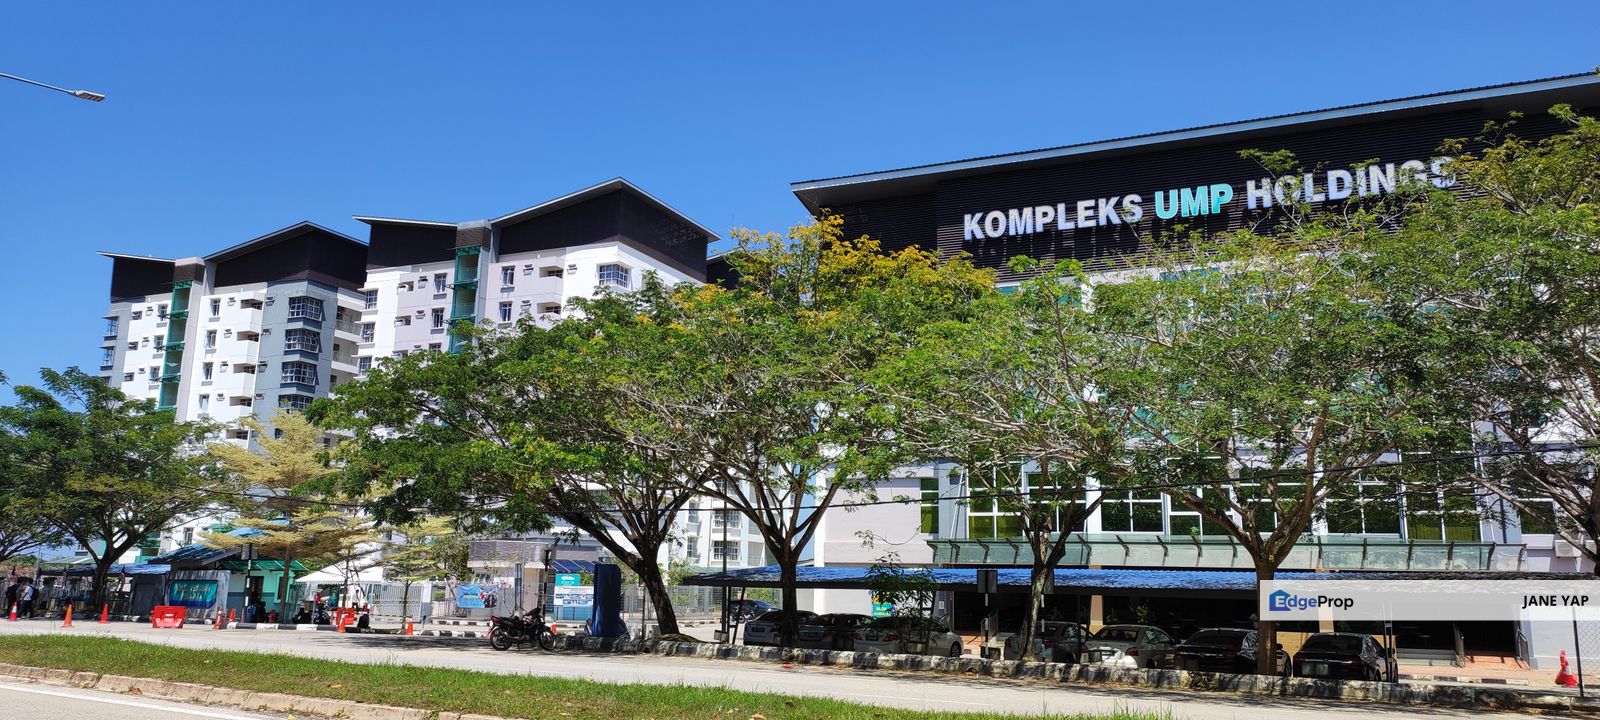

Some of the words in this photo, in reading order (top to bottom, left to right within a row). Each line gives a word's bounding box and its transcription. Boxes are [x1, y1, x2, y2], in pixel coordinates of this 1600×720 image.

[963, 194, 1144, 241] KOMPLEKS
[1154, 183, 1234, 220] UMP
[1246, 156, 1457, 210] HOLDINGS
